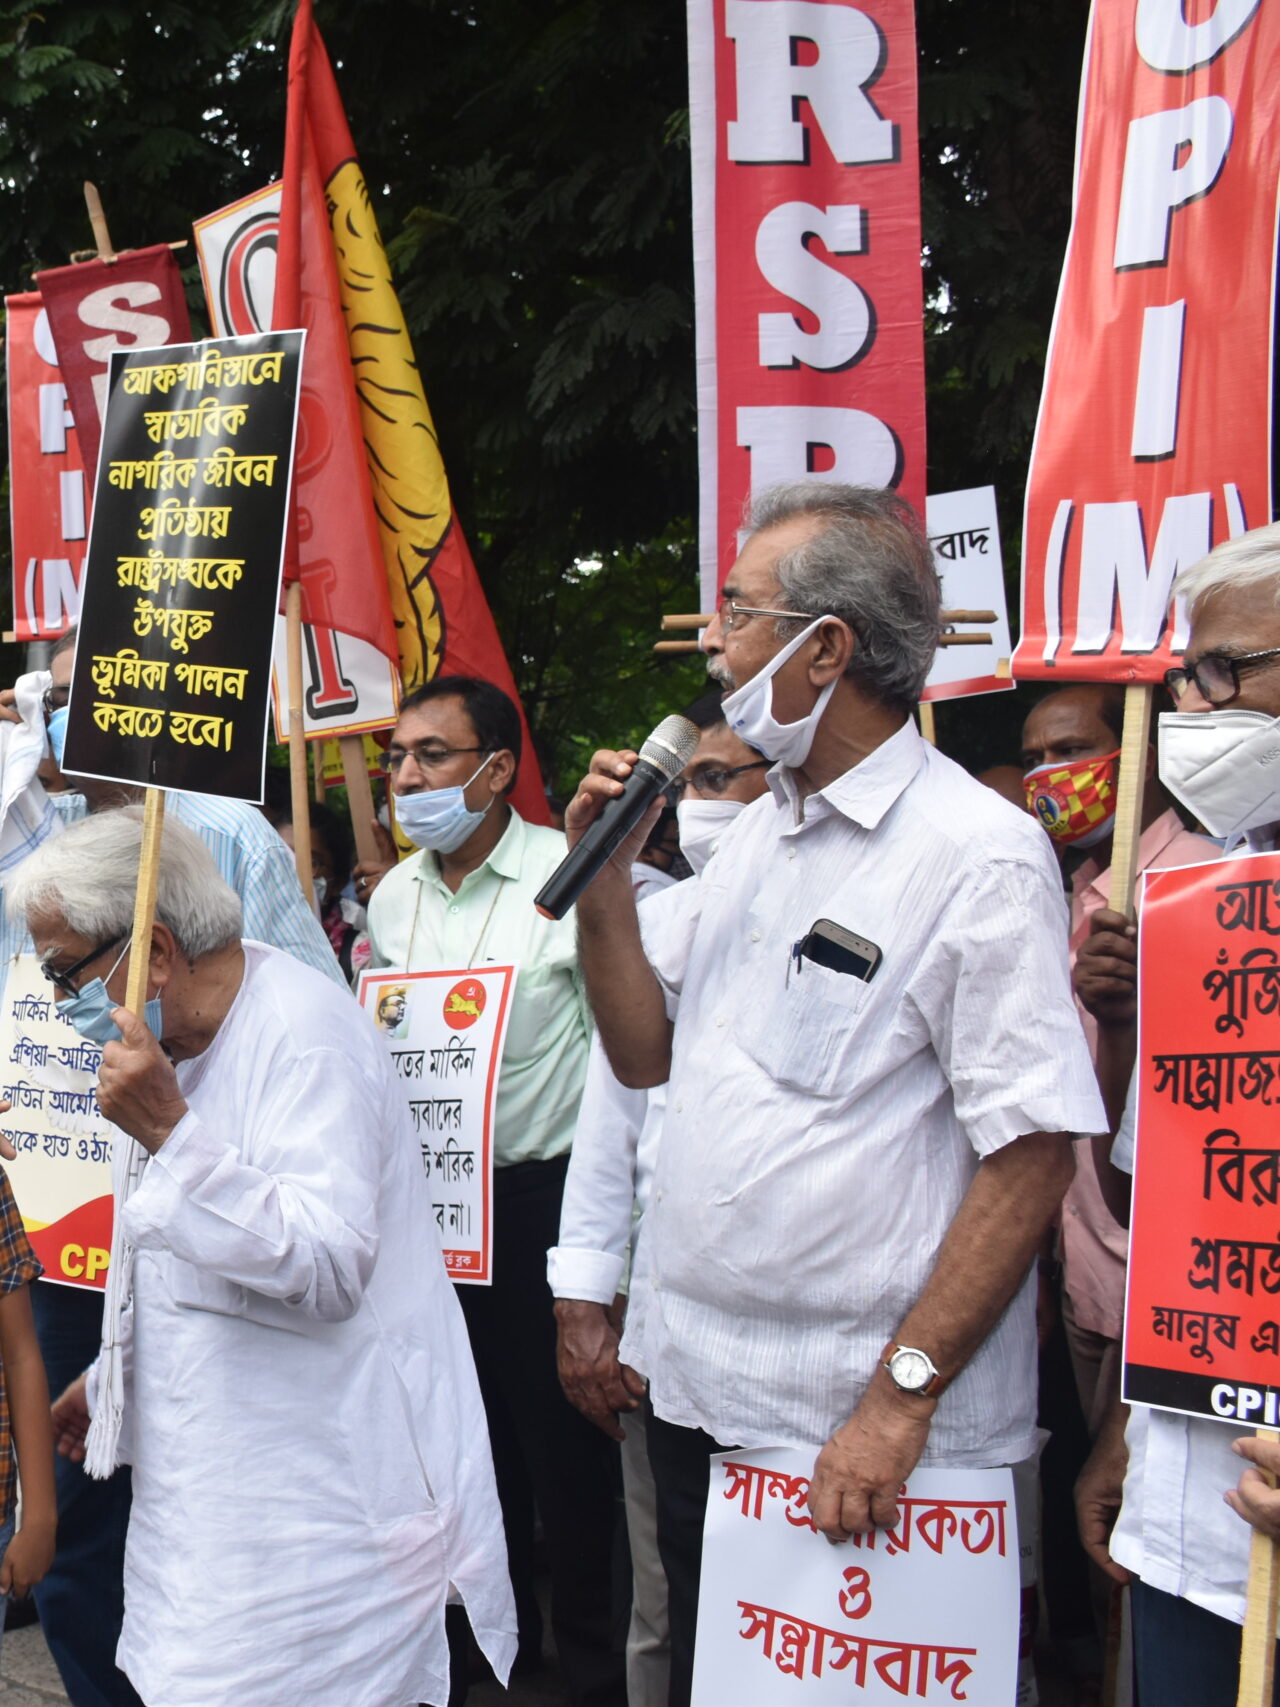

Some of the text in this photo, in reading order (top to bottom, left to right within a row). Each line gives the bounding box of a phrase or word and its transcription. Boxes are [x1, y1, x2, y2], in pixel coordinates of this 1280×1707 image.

[122, 350, 285, 395] আফগানিস্তানে
[144, 396, 249, 444] স্বাভাবিক
[108, 445, 278, 490] নাগরিক জীবন
[137, 497, 232, 542] প্রতিষ্ঠায়
[929, 527, 991, 561] বাদ
[133, 598, 215, 655] উপযুক্ত
[91, 648, 249, 701] ভূমিকা পালন
[92, 700, 165, 740] করতে
[12, 994, 52, 1023] মার্কিন
[1202, 948, 1280, 1039] পুঁজি
[430, 1035, 477, 1080] মার্কিন
[2, 1080, 44, 1110] লাতিন
[1152, 1050, 1280, 1114] সাম্রাজ
[42, 1133, 72, 1158] হাত
[434, 1137, 475, 1183] শরিক
[60, 1243, 111, 1281] CP
[1151, 1305, 1280, 1365] মানুষ এ
[1210, 1383, 1280, 1426] CPI
[838, 1566, 872, 1620] ও
[737, 1600, 977, 1701] সন্ত্রাসবাদ
